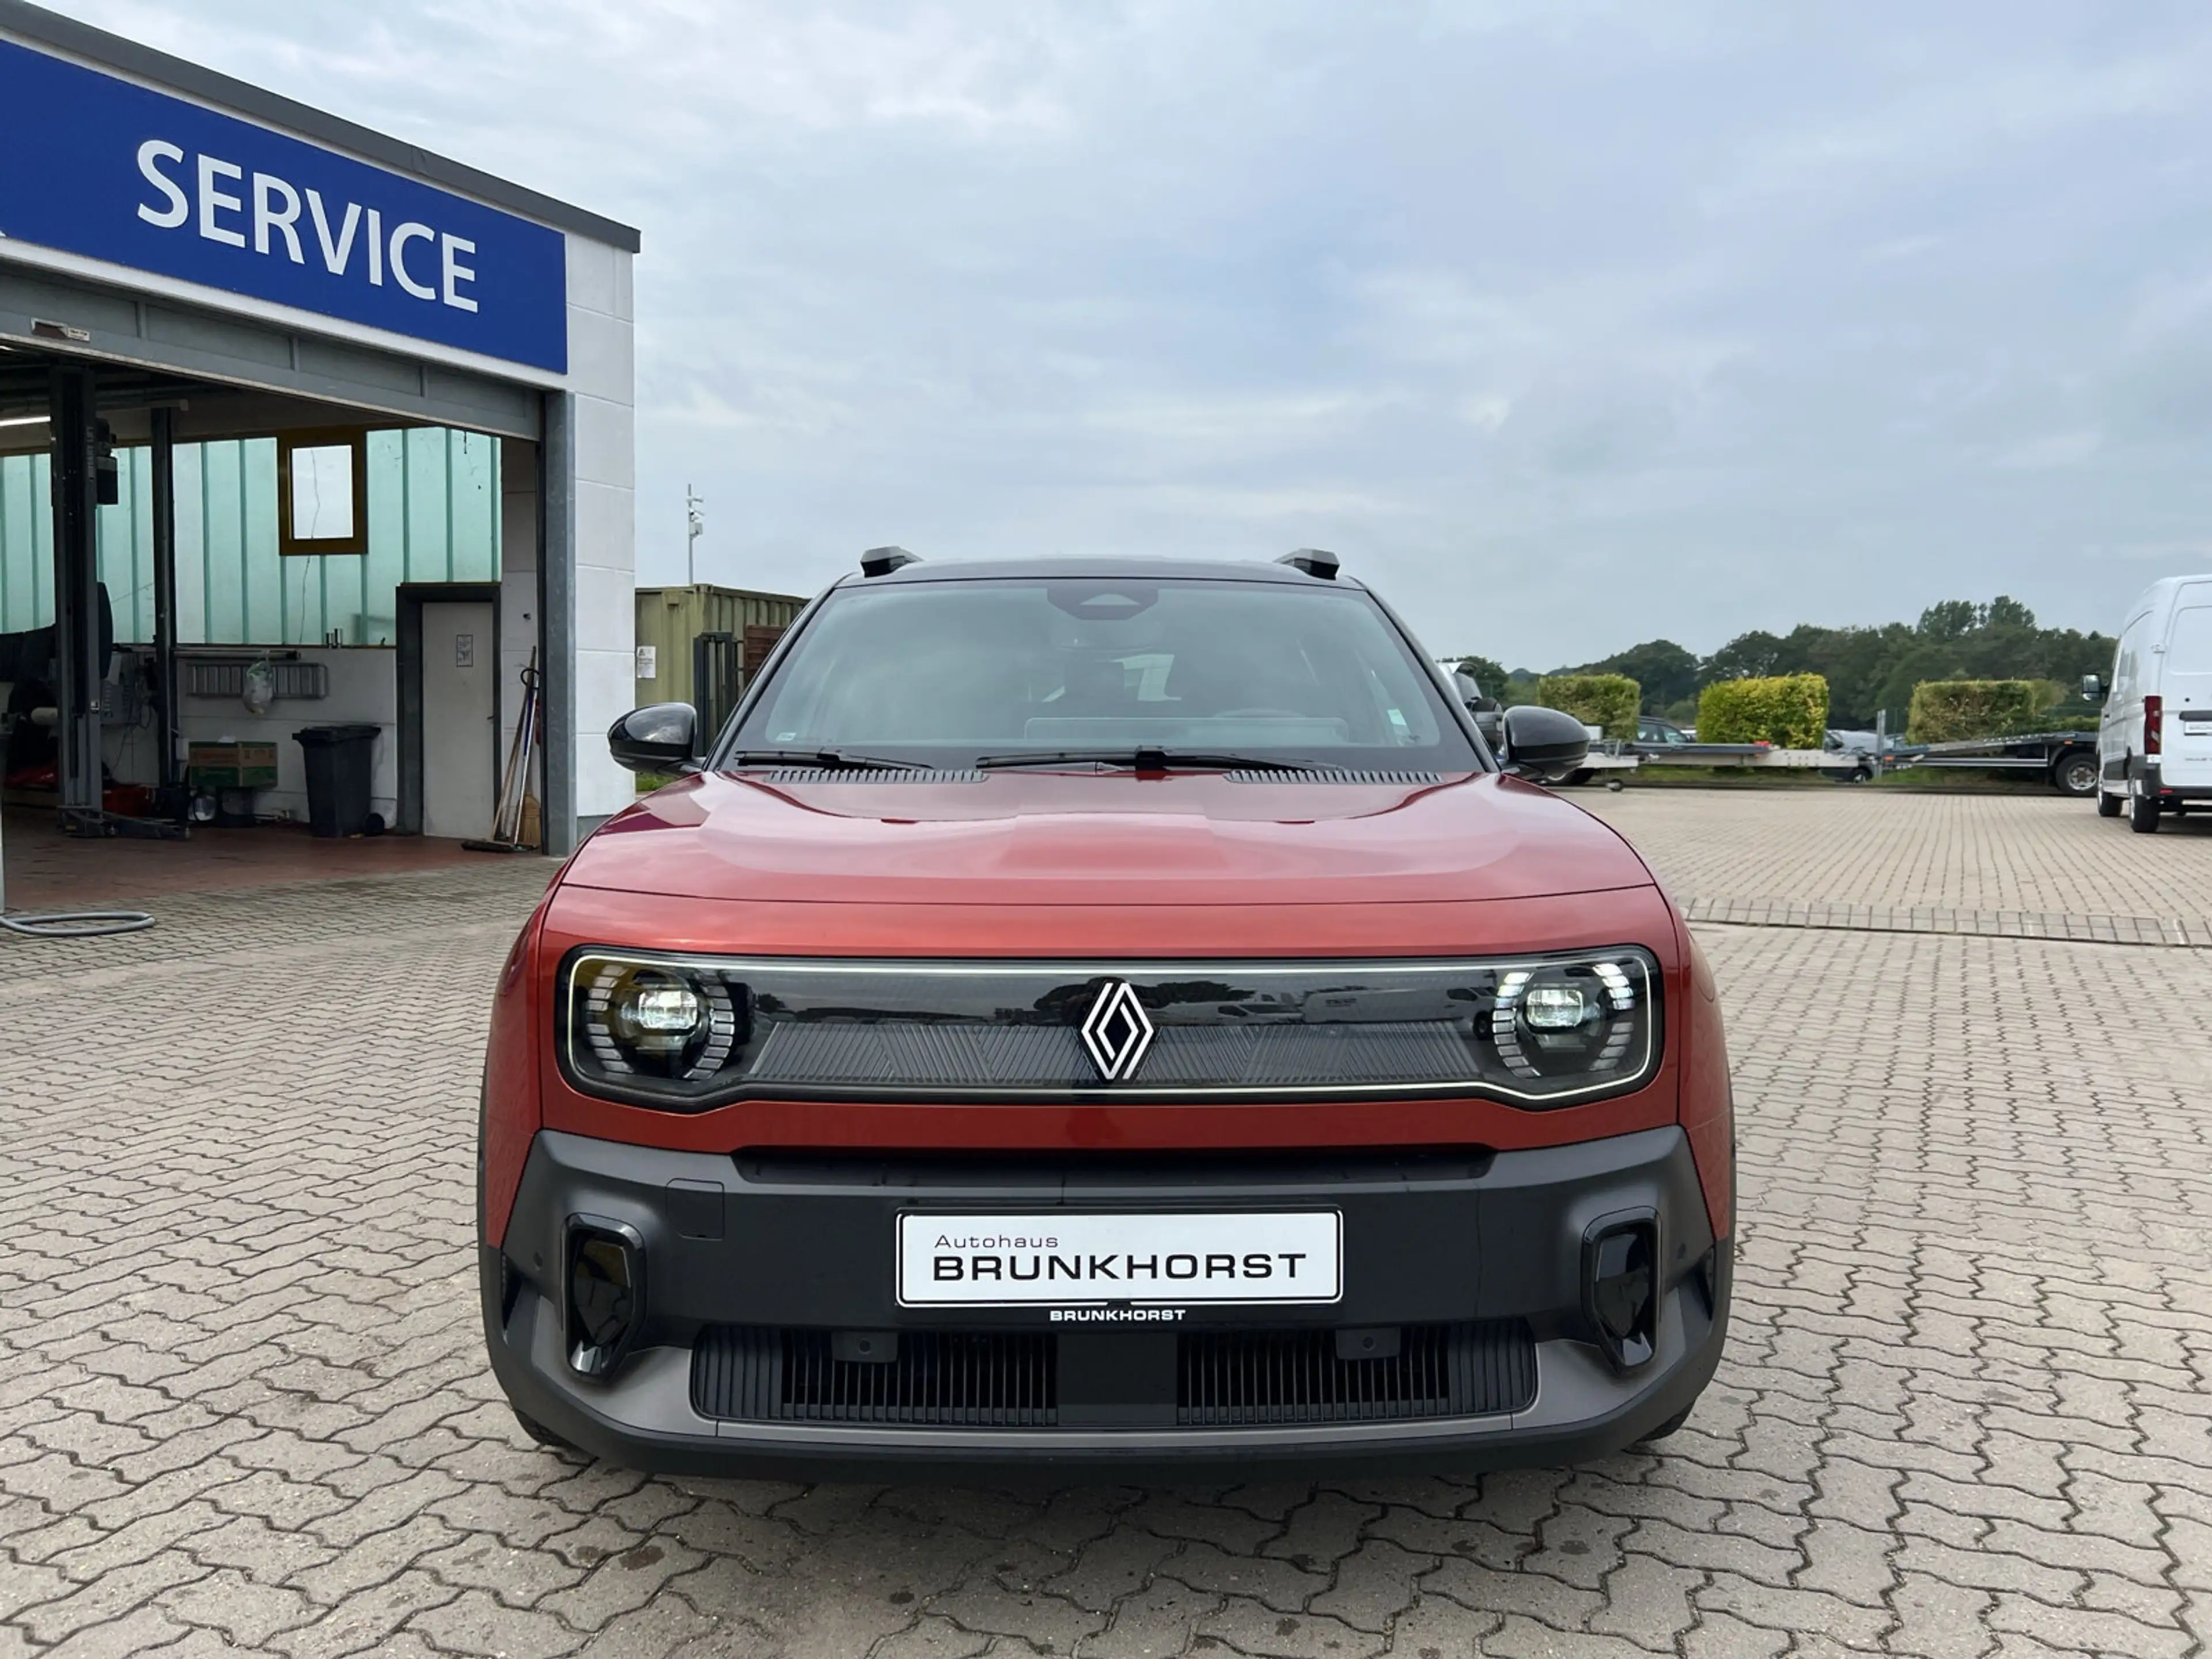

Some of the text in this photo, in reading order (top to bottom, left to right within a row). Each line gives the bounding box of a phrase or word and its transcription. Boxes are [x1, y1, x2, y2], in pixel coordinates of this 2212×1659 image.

[137, 139, 479, 313] SERVICE
[934, 1234, 1058, 1249] Autohaus
[934, 1253, 1306, 1281] BRUNKHORST
[1050, 1309, 1187, 1321] BRUNKHORST
